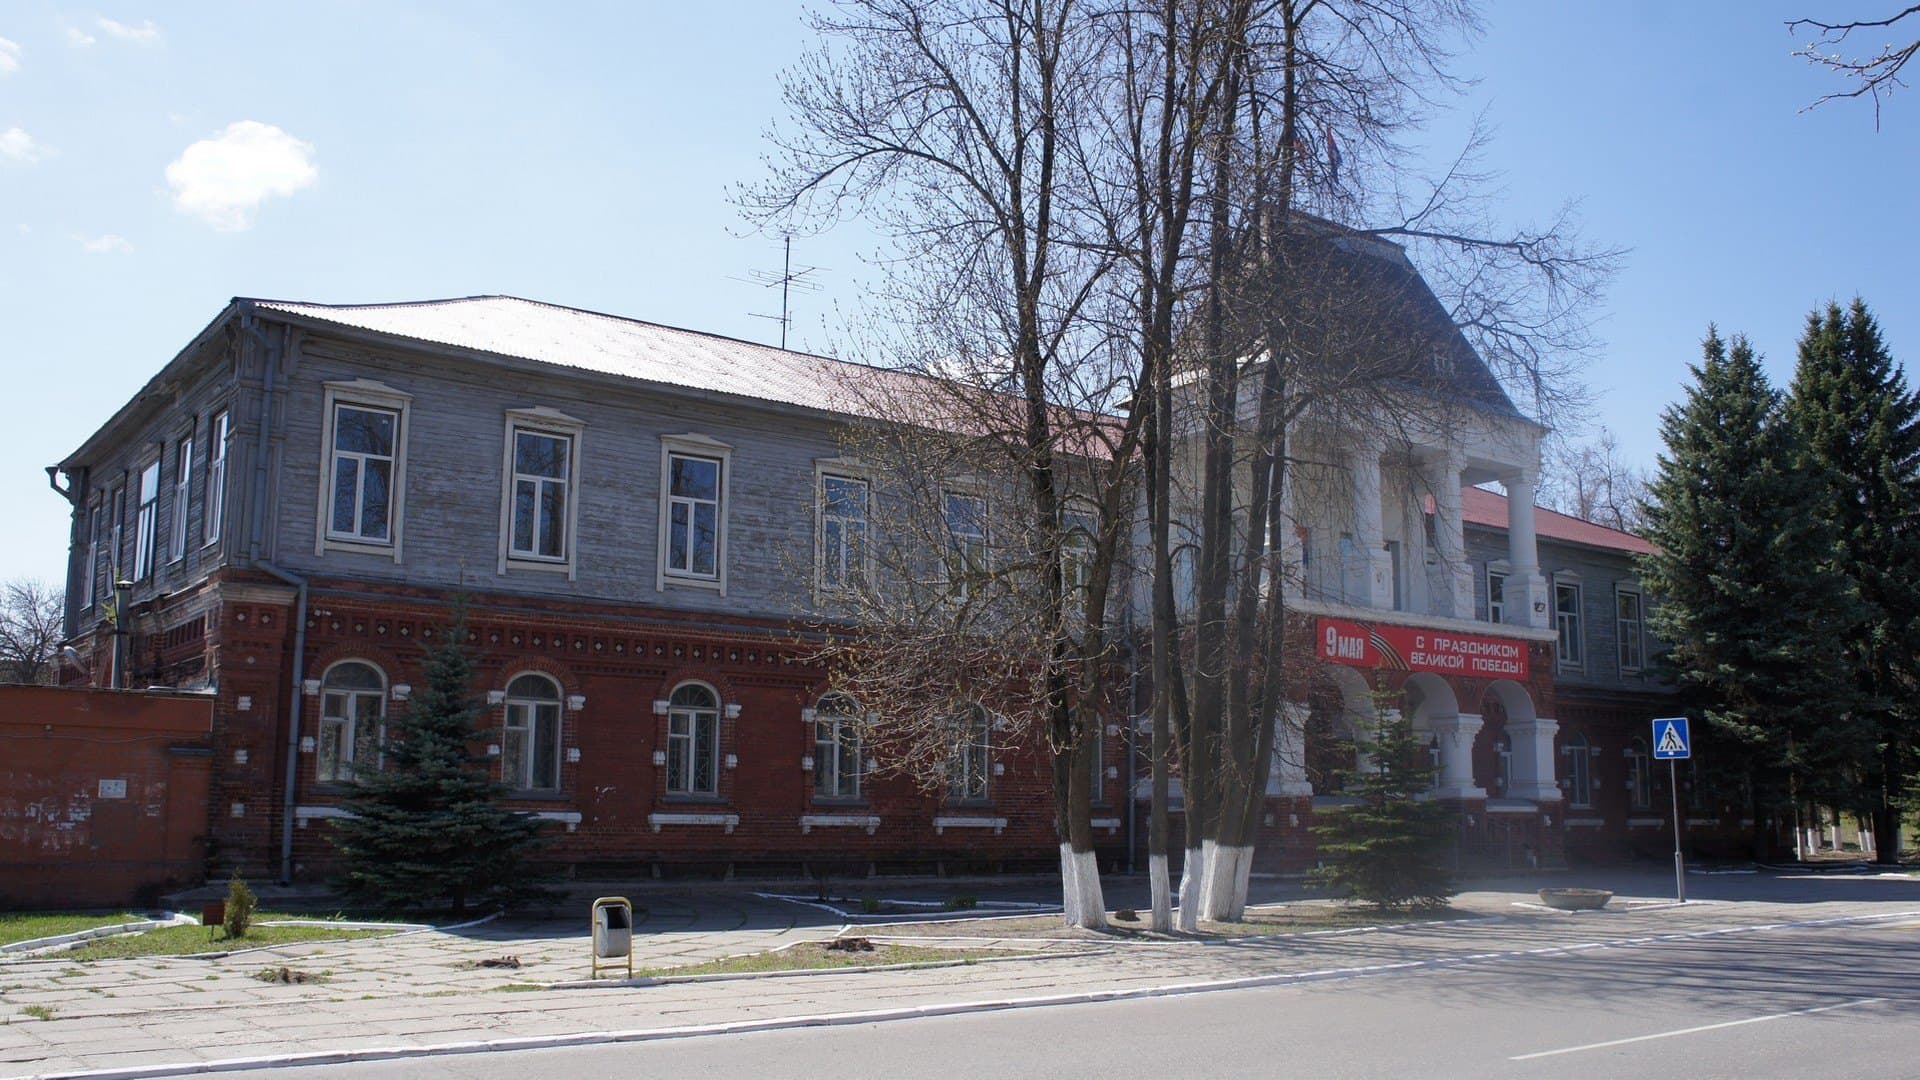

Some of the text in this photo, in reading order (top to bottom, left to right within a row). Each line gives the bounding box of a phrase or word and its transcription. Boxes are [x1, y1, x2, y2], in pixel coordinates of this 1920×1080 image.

[1326, 626, 1364, 660] 9 МАЯ
[1416, 636, 1519, 657] С ПРАЗДНИКОМ
[1411, 651, 1523, 674] ВЕЛИКОЙ ПОБЕДЫ!
